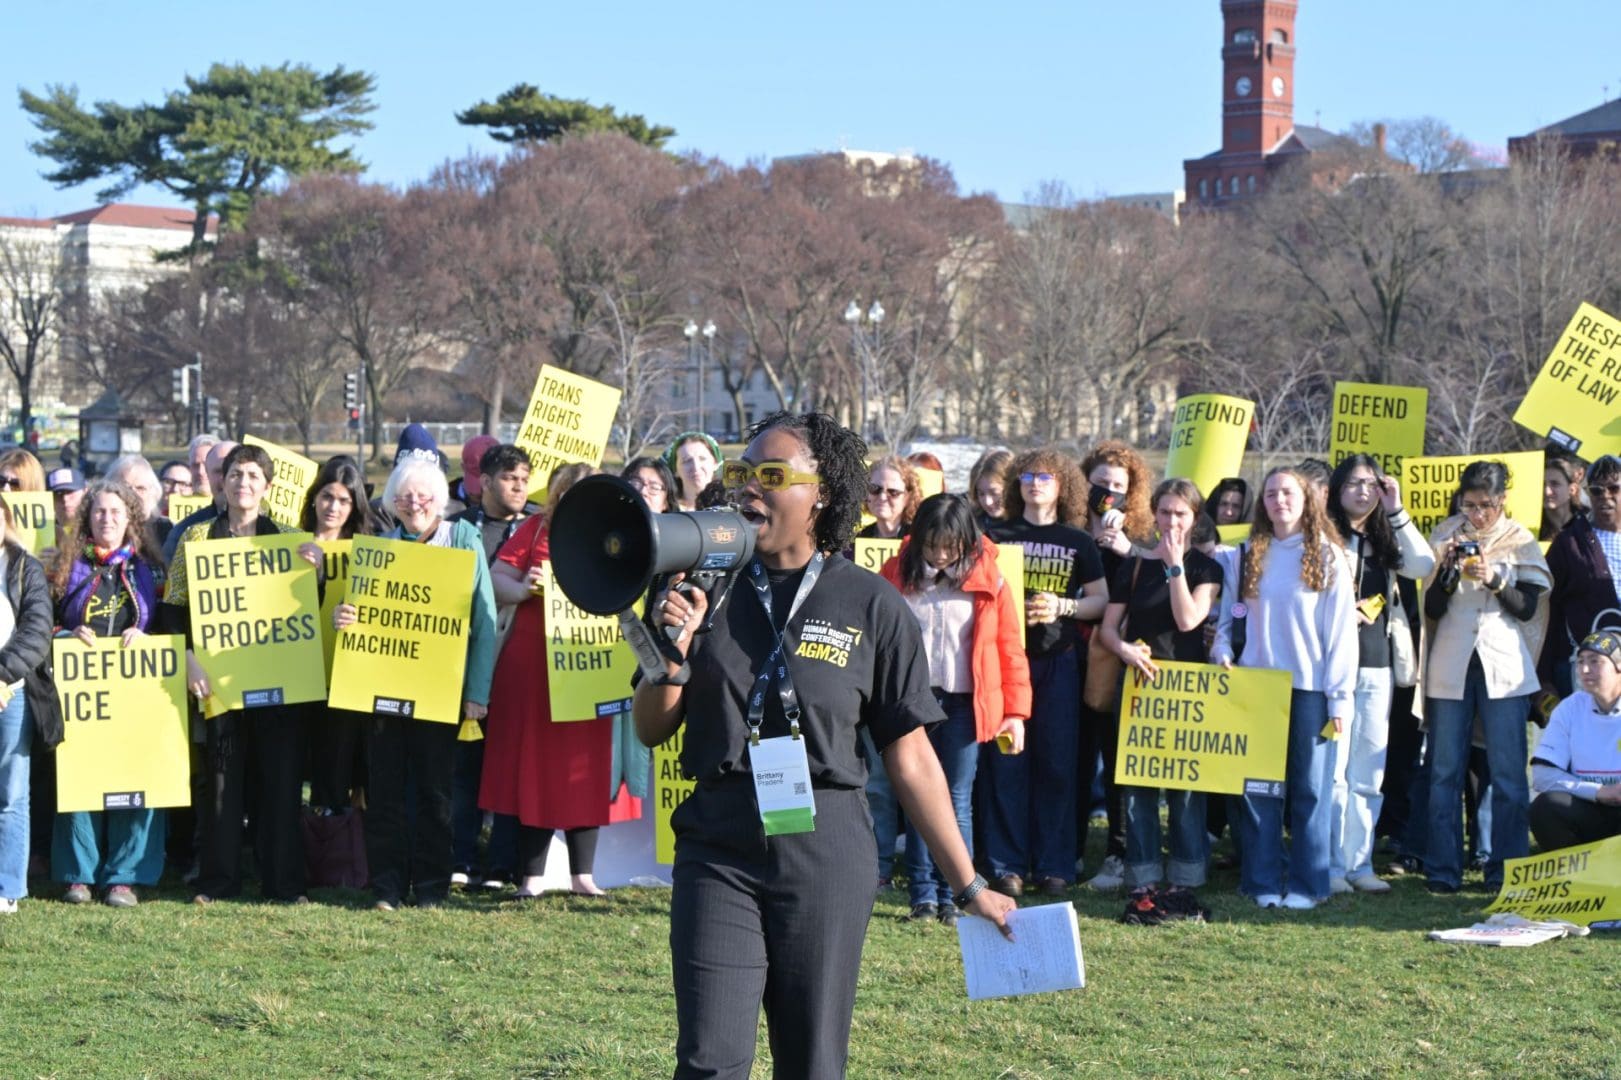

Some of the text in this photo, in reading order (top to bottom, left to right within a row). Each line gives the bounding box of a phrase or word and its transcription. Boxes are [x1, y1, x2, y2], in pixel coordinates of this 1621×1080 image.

[1563, 336, 1600, 368] THE
[541, 376, 583, 406] TRANS
[1550, 359, 1620, 406] OF LAW
[532, 400, 582, 431] RIGHTS
[1176, 402, 1246, 426] DEFUND
[1339, 393, 1408, 420] DEFEND
[523, 423, 601, 462] ARE HUMAN
[1172, 427, 1196, 451] ICE
[1336, 421, 1371, 445] DUE
[195, 548, 292, 581] DEFEND
[354, 547, 396, 570] STOP
[198, 586, 248, 615] DUE
[350, 575, 432, 604] THE MASS
[201, 613, 316, 650] PROCESS
[350, 604, 462, 637] EPORTATION
[341, 632, 420, 660] MACHINE
[552, 626, 564, 645] A
[62, 648, 178, 682] DEFUND
[554, 650, 613, 671] RIGHT
[795, 641, 849, 667] AGM26
[1132, 665, 1230, 696] WOMEN'S
[64, 690, 112, 722] ICE
[1130, 696, 1205, 723] RIGHTS
[1126, 725, 1248, 757] ARE HUMAN
[756, 772, 784, 780] Brittany
[1125, 754, 1200, 782] RIGHTS
[1511, 851, 1592, 886] STUDENT
[1502, 881, 1572, 905] RIGHTS
[1534, 896, 1607, 915] HUMAN
